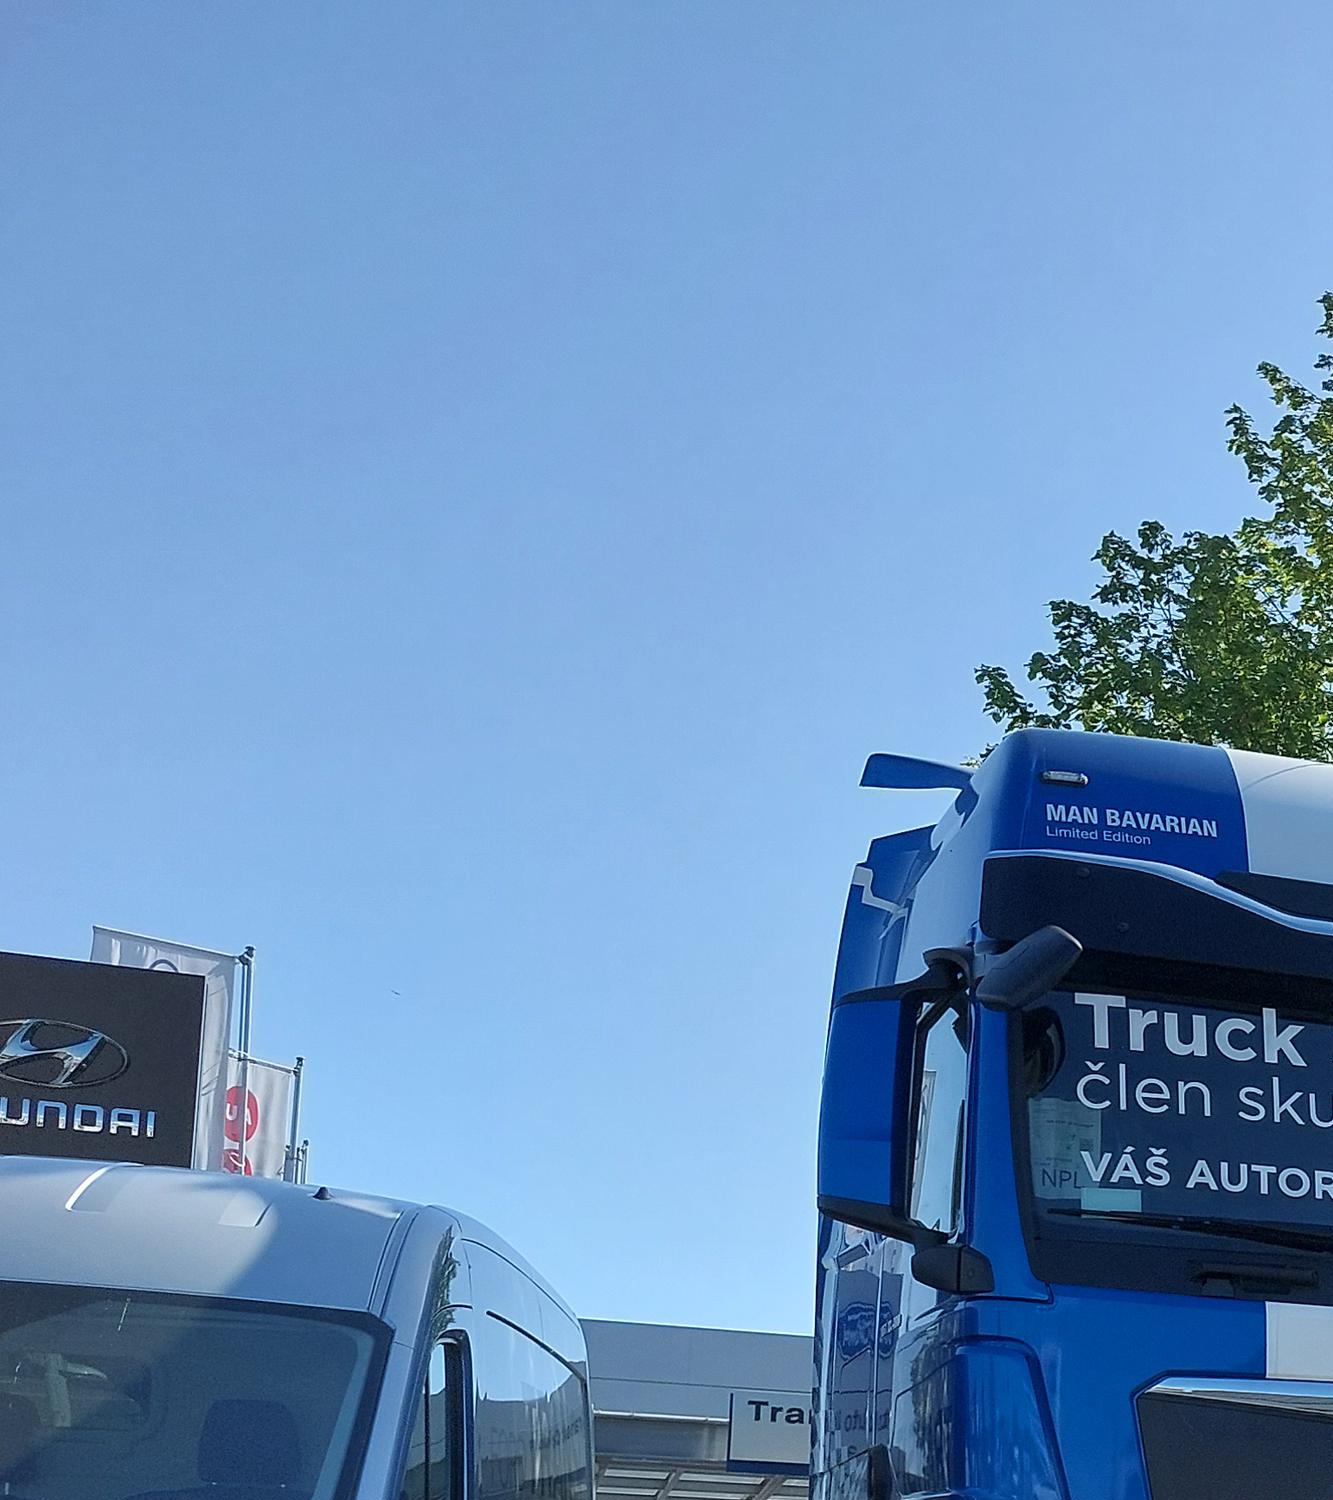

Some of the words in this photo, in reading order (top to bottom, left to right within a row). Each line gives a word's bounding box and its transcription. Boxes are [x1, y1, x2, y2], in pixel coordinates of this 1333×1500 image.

[1046, 803, 1098, 825] MAN
[1106, 808, 1218, 838] BAVARIAN
[1046, 825, 1098, 840] Limited
[1103, 830, 1152, 845] Edition
[1074, 992, 1308, 1067] Truck
[1076, 1061, 1212, 1117] člen
[1080, 1146, 1172, 1187] VÁŠ
[747, 1400, 812, 1425] Tra
